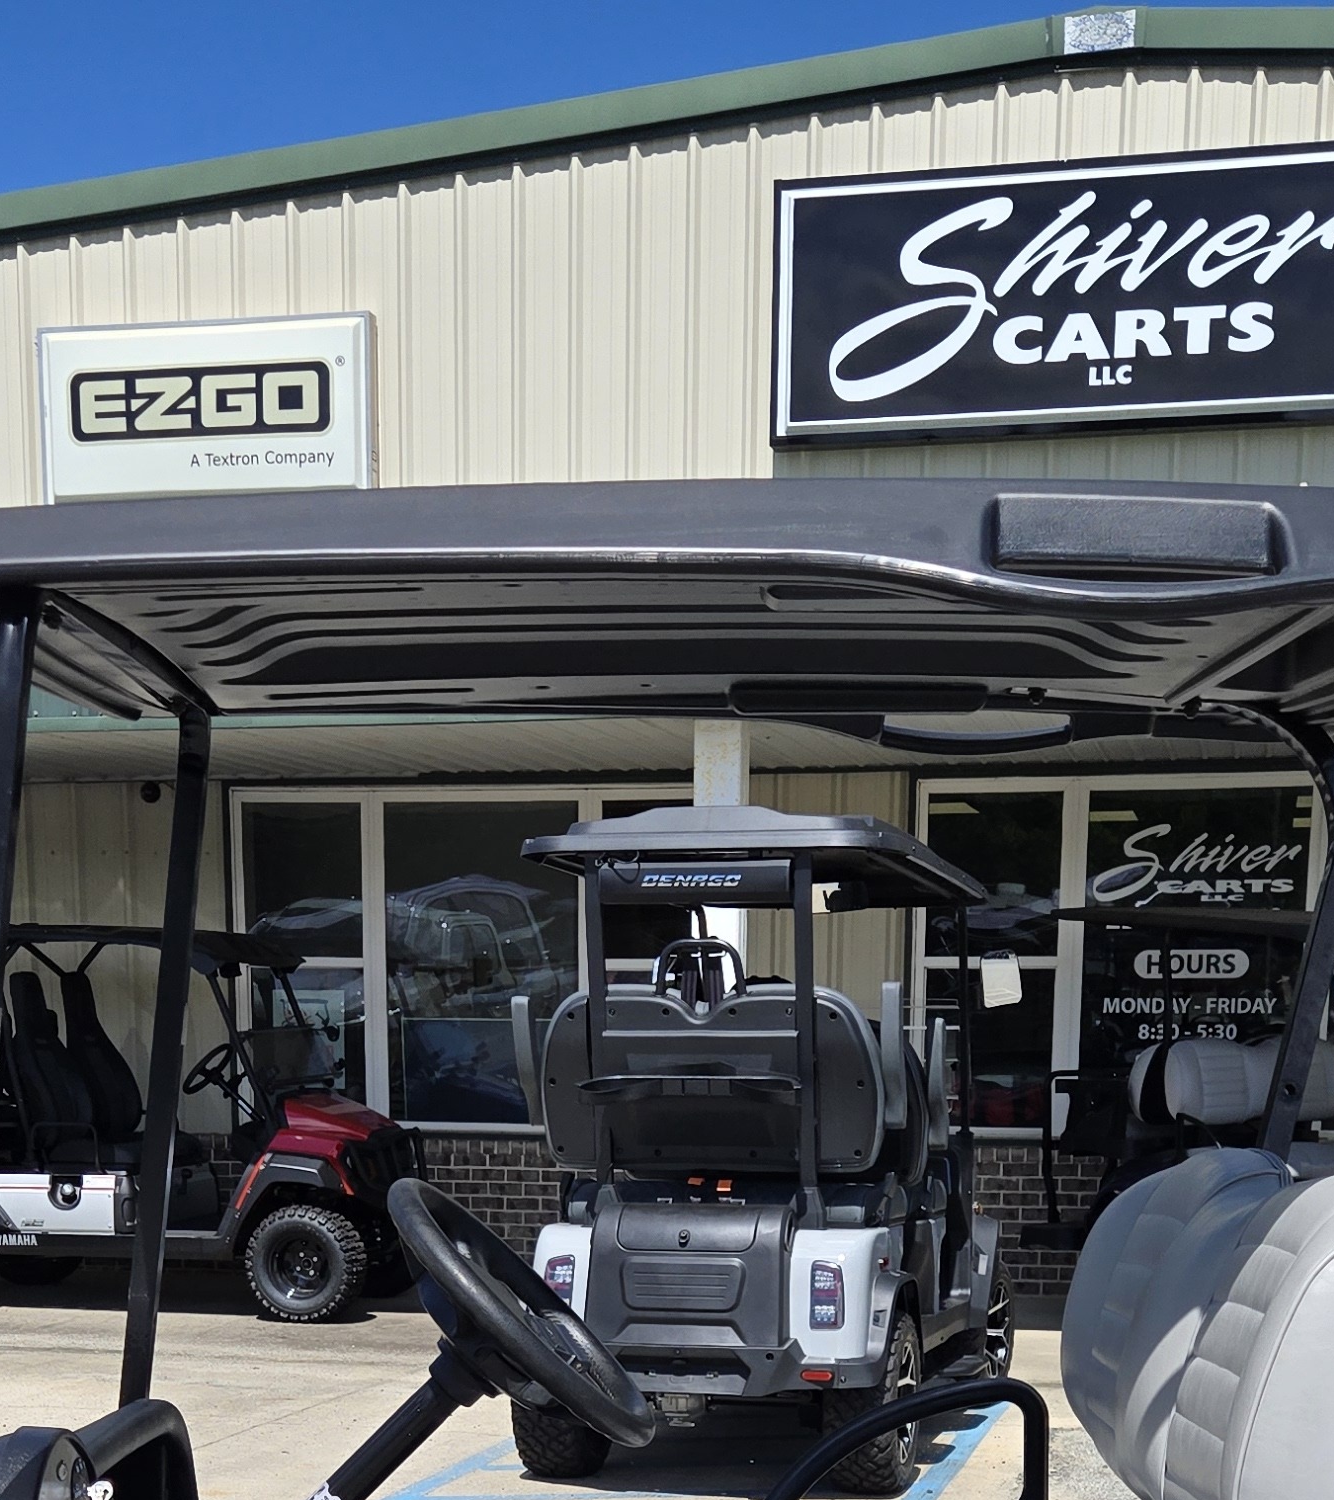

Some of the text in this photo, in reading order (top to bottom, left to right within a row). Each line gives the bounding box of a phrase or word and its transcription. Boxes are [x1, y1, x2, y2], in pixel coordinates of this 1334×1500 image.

[992, 301, 1276, 365] CARTS
[1088, 364, 1133, 386] LLC
[78, 369, 320, 434] EZGO
[190, 450, 335, 468] A Textron Company
[1092, 823, 1303, 903] Shiver
[640, 874, 742, 887] DENAGO
[1156, 878, 1295, 894] CARTS
[1200, 893, 1245, 903] LLC
[1146, 953, 1236, 975] HOURS
[1205, 996, 1278, 1014] FRIDAY
[1196, 1023, 1238, 1040] 5:30
